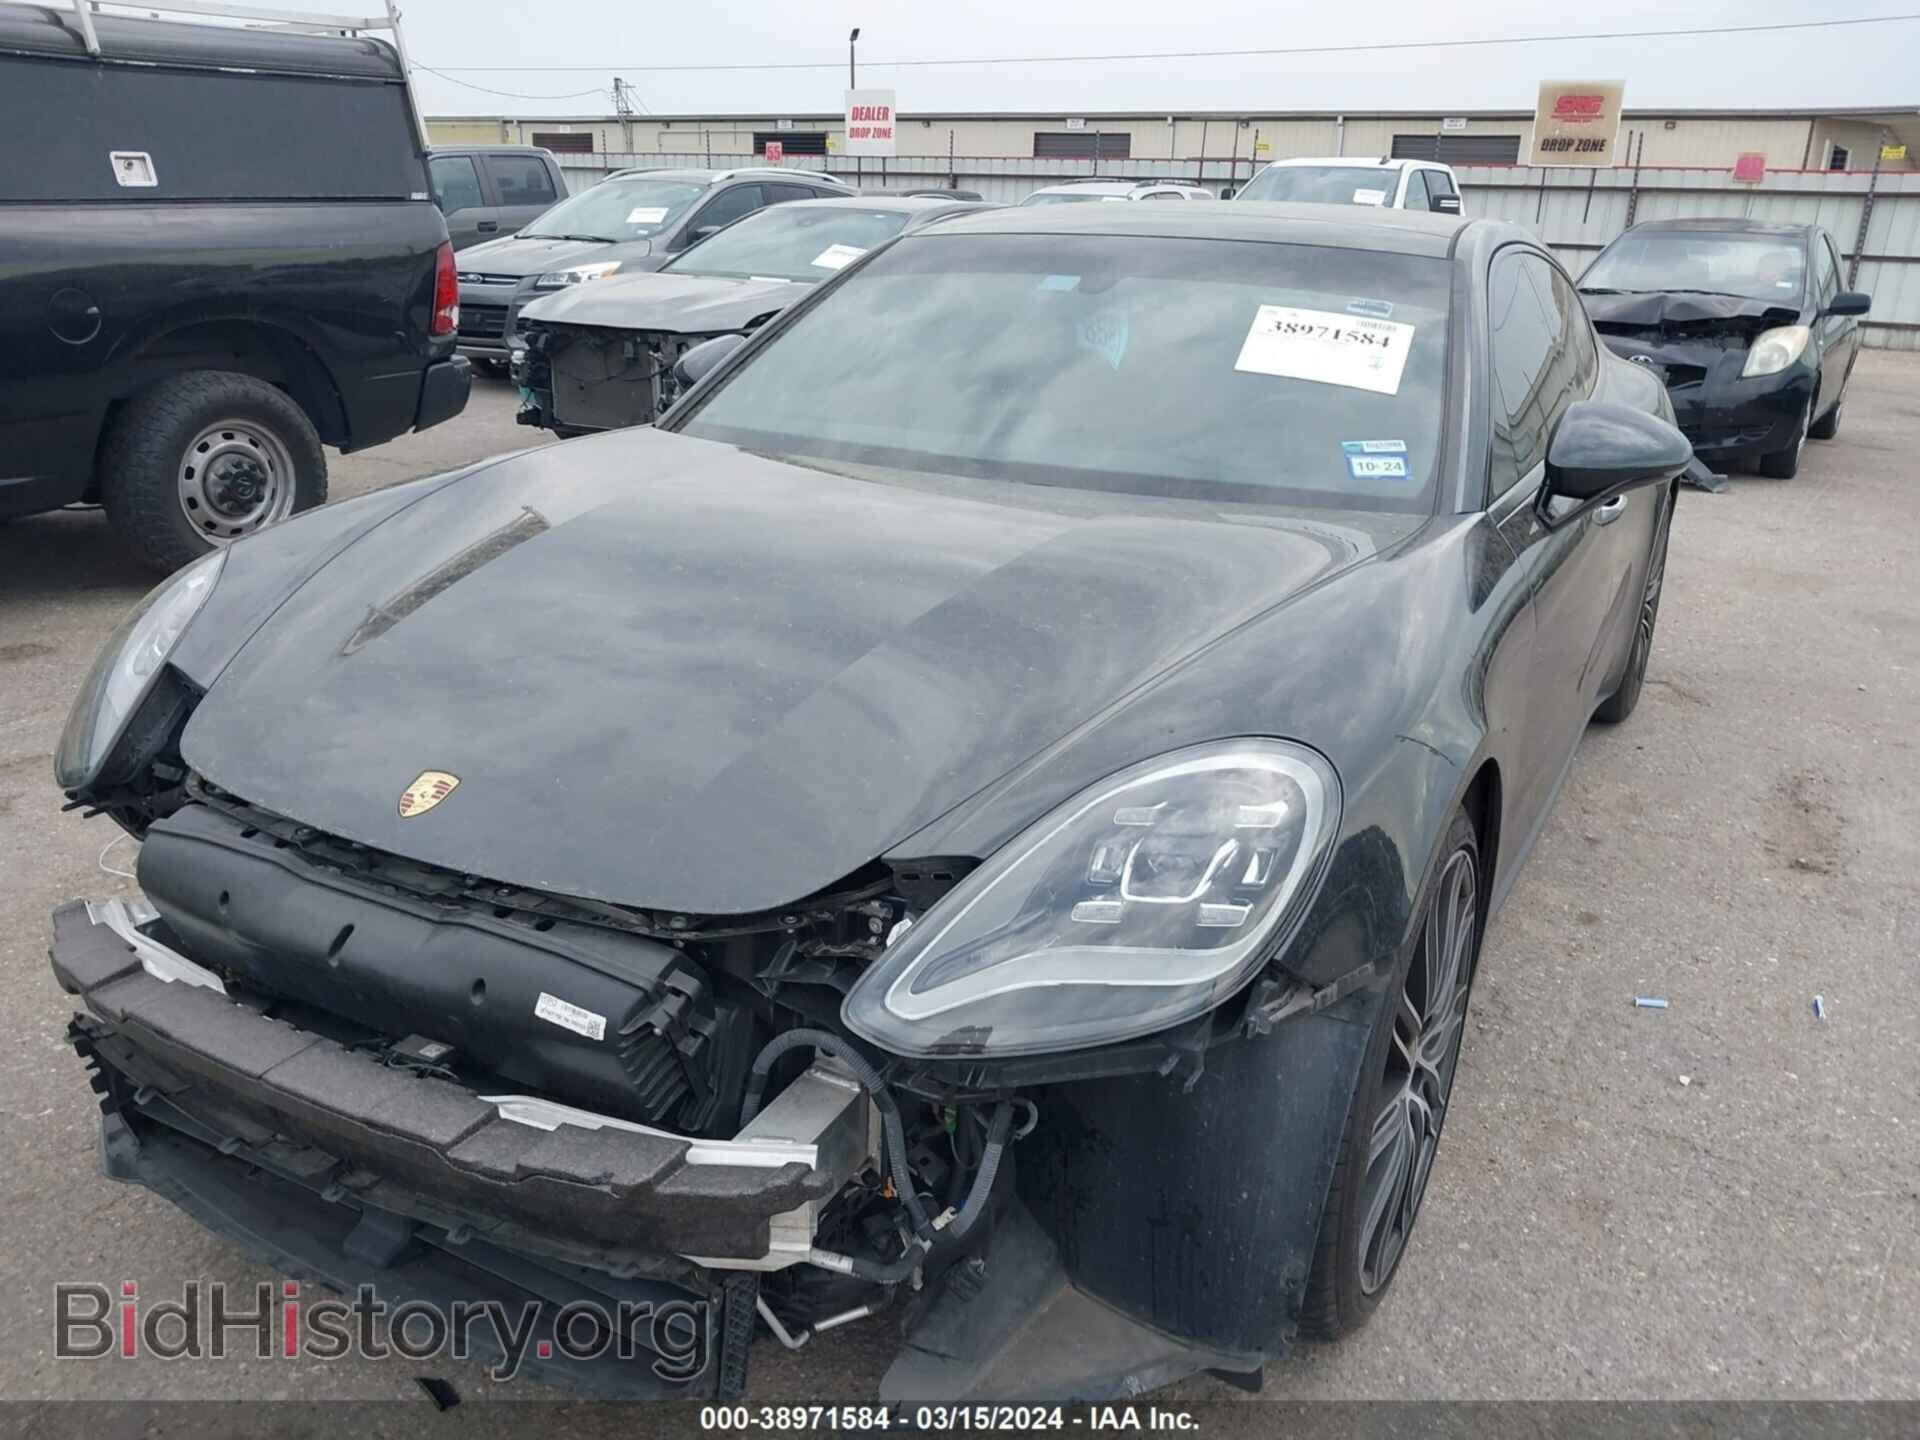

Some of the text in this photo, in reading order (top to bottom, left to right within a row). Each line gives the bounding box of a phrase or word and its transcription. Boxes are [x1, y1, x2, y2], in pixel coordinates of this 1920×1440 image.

[851, 106, 890, 121] DEALER
[849, 127, 892, 139] DROP ZONE
[1541, 138, 1607, 152] DROP ZONE
[1267, 319, 1390, 348] 38971584
